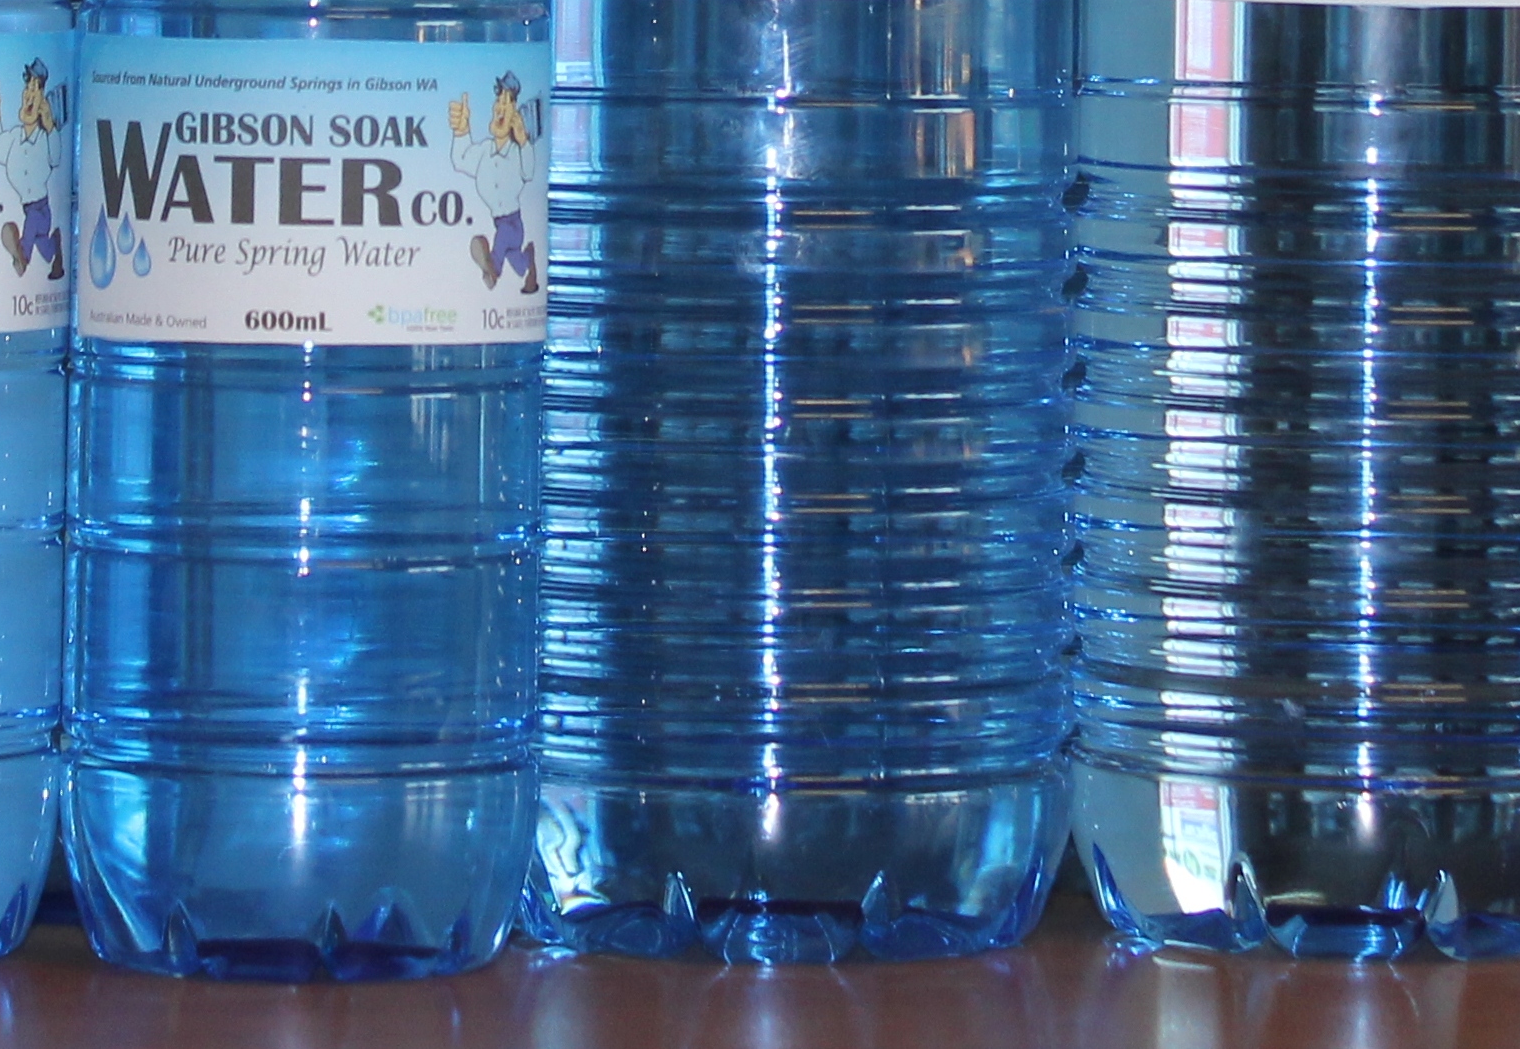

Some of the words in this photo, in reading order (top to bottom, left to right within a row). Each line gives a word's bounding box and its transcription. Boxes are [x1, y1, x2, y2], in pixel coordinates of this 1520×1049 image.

[92, 71, 121, 85] Sourced
[122, 71, 146, 86] from
[148, 73, 191, 87] Natural
[194, 74, 286, 92] Underground
[290, 76, 343, 93] Springs
[347, 77, 361, 90] in
[365, 78, 411, 91] Gibson
[416, 79, 438, 92] WA
[174, 111, 314, 147] GIBSON
[329, 114, 429, 148] SOAK
[96, 119, 403, 227] WATER
[411, 190, 474, 226] CO.
[168, 237, 226, 263] Pure
[235, 239, 326, 275] Spring
[338, 236, 420, 268] Water
[12, 294, 34, 317] 10c
[388, 305, 457, 326] bpafree
[89, 310, 123, 326] Australian
[125, 312, 153, 327] Made
[155, 315, 164, 327] &
[166, 315, 206, 329] Owned
[244, 310, 332, 332] 600mL
[481, 308, 505, 330] 10c
